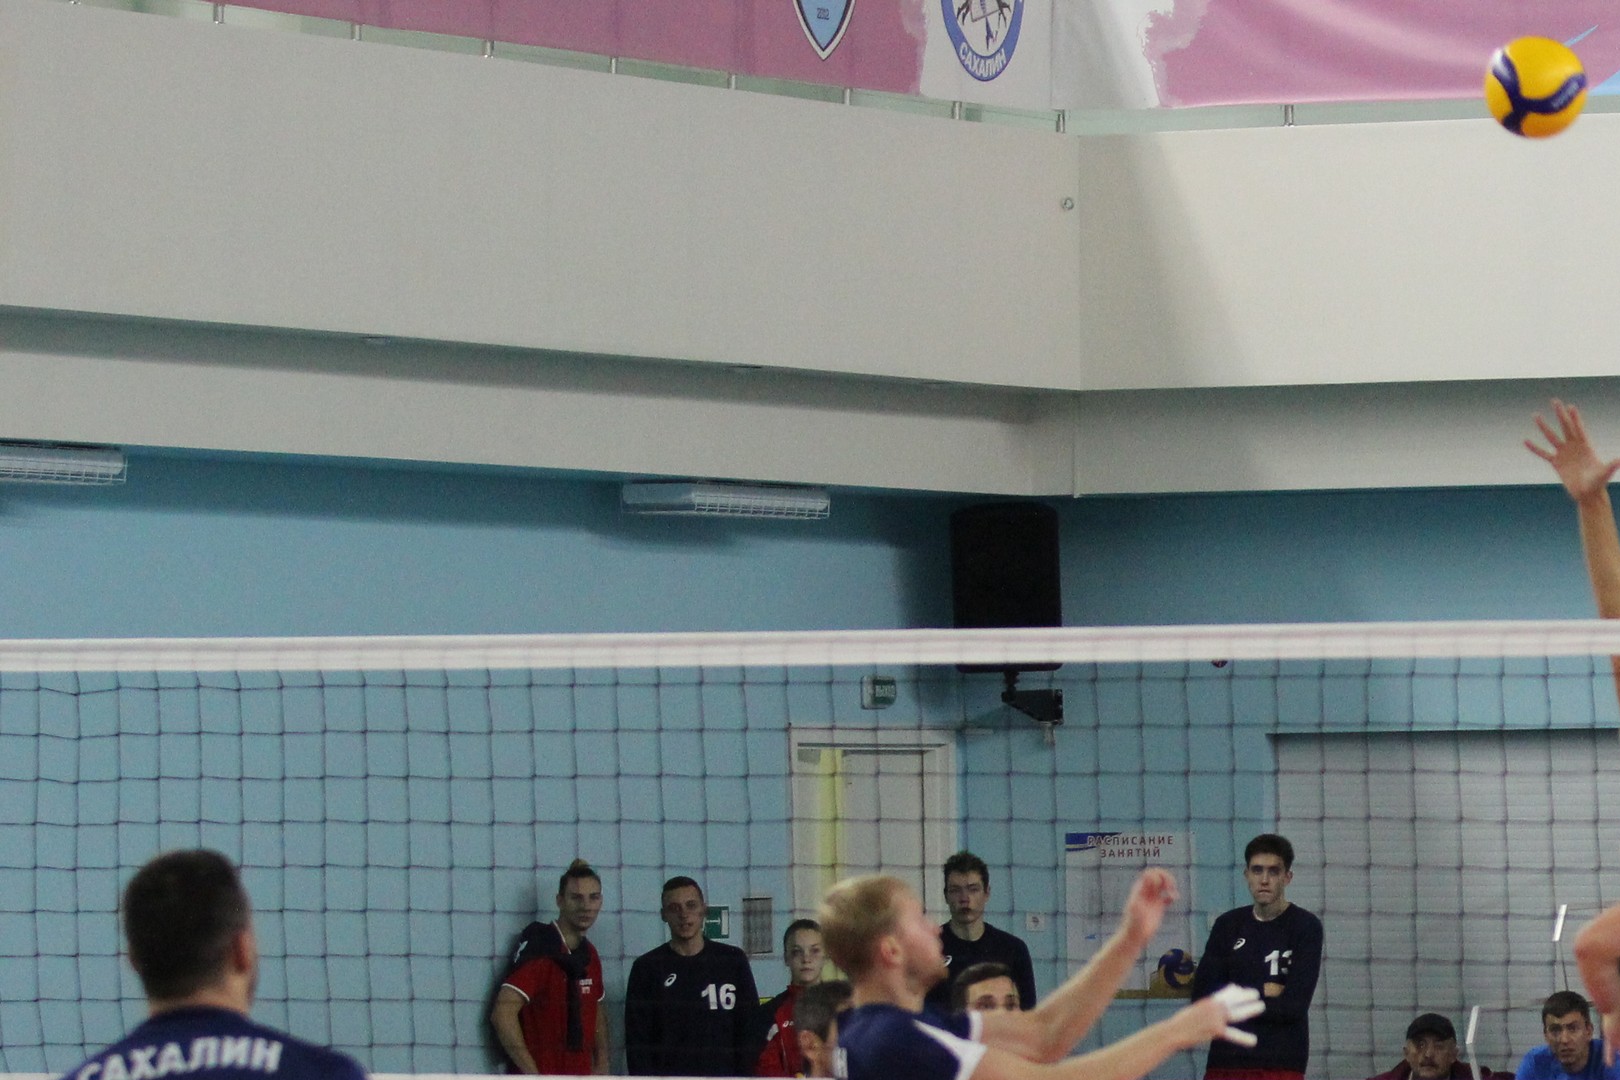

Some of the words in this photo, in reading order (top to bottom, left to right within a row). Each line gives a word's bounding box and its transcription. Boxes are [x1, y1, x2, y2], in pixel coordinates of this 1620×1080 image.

[960, 42, 1007, 78] САХАЛИН
[1087, 836, 1174, 846] РАСПИСАНИЕ
[1100, 847, 1161, 858] ЗАНЯТИЙ
[701, 983, 737, 1011] 16
